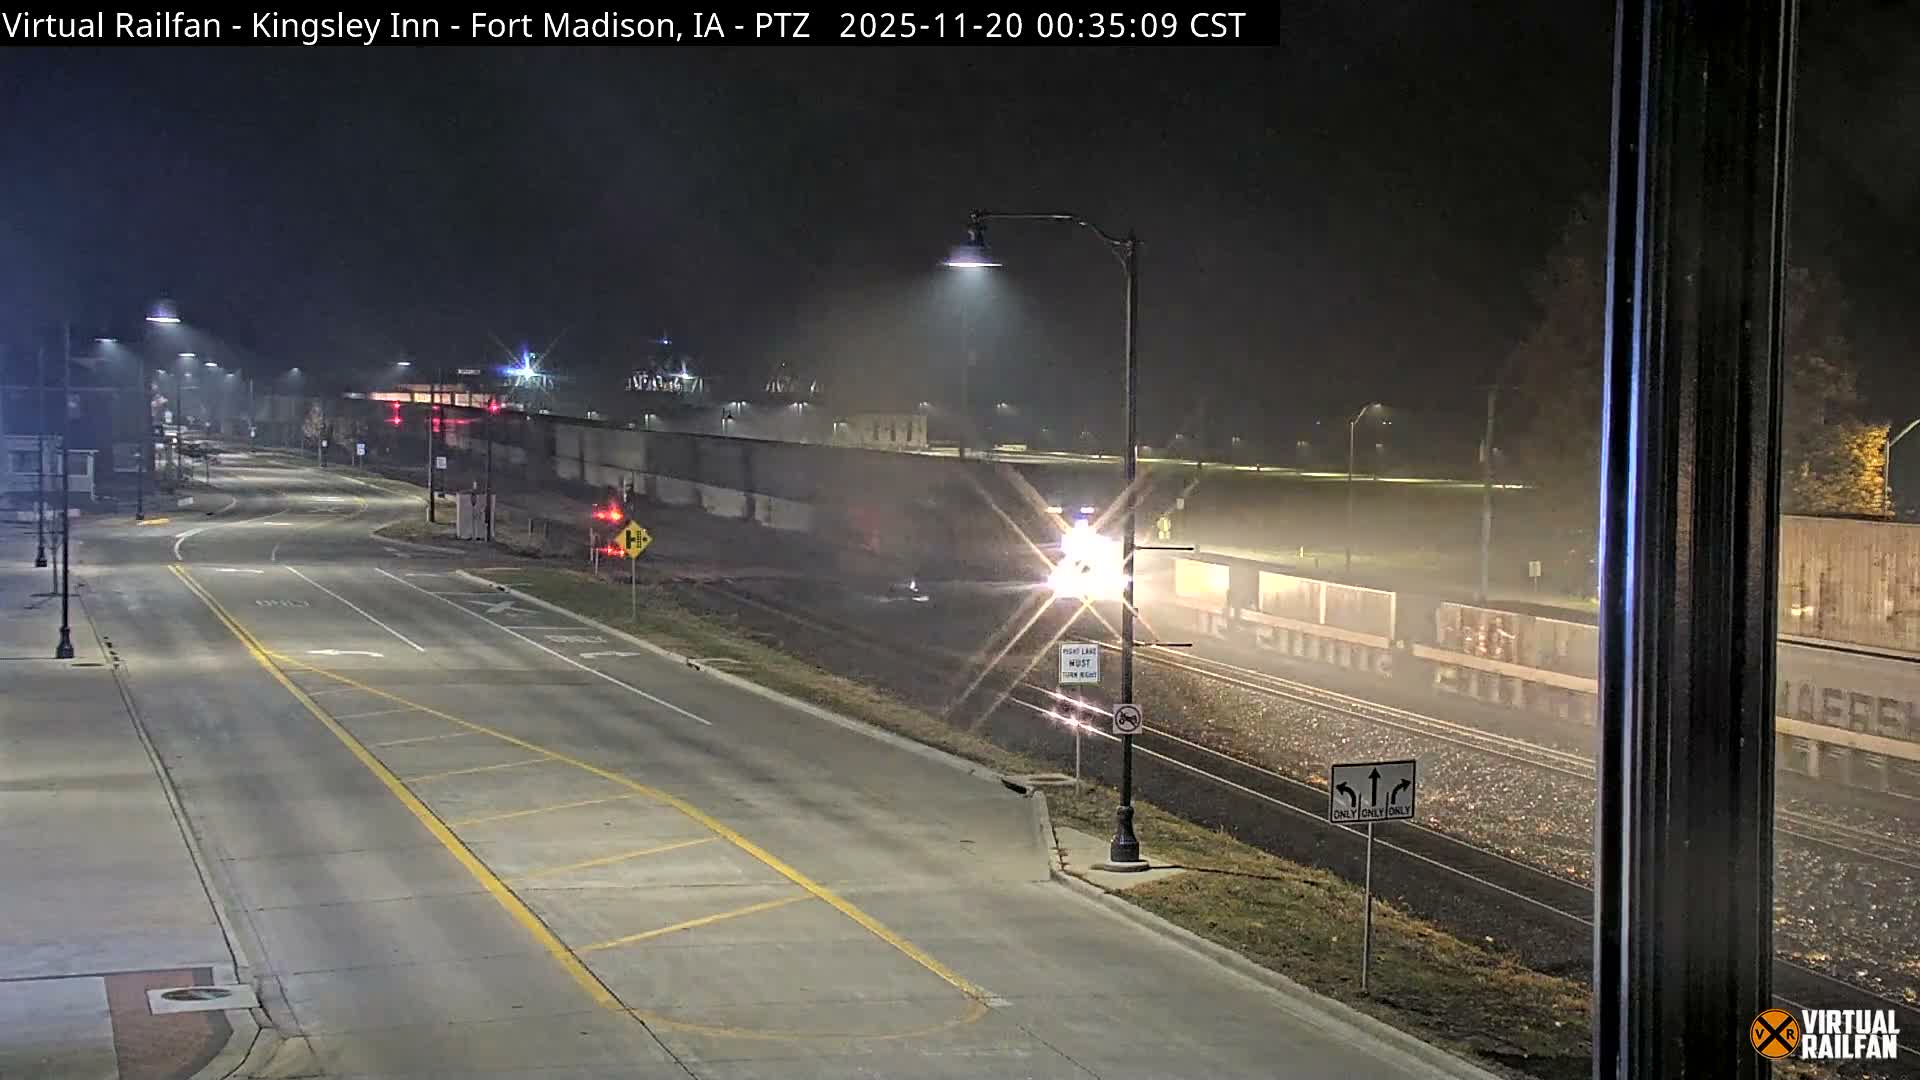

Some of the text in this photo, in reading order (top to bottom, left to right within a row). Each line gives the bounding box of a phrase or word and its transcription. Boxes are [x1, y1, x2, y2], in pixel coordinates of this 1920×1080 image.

[1069, 658, 1091, 668] MUST
[1334, 805, 1411, 820] ONLY ONLY ONLY
